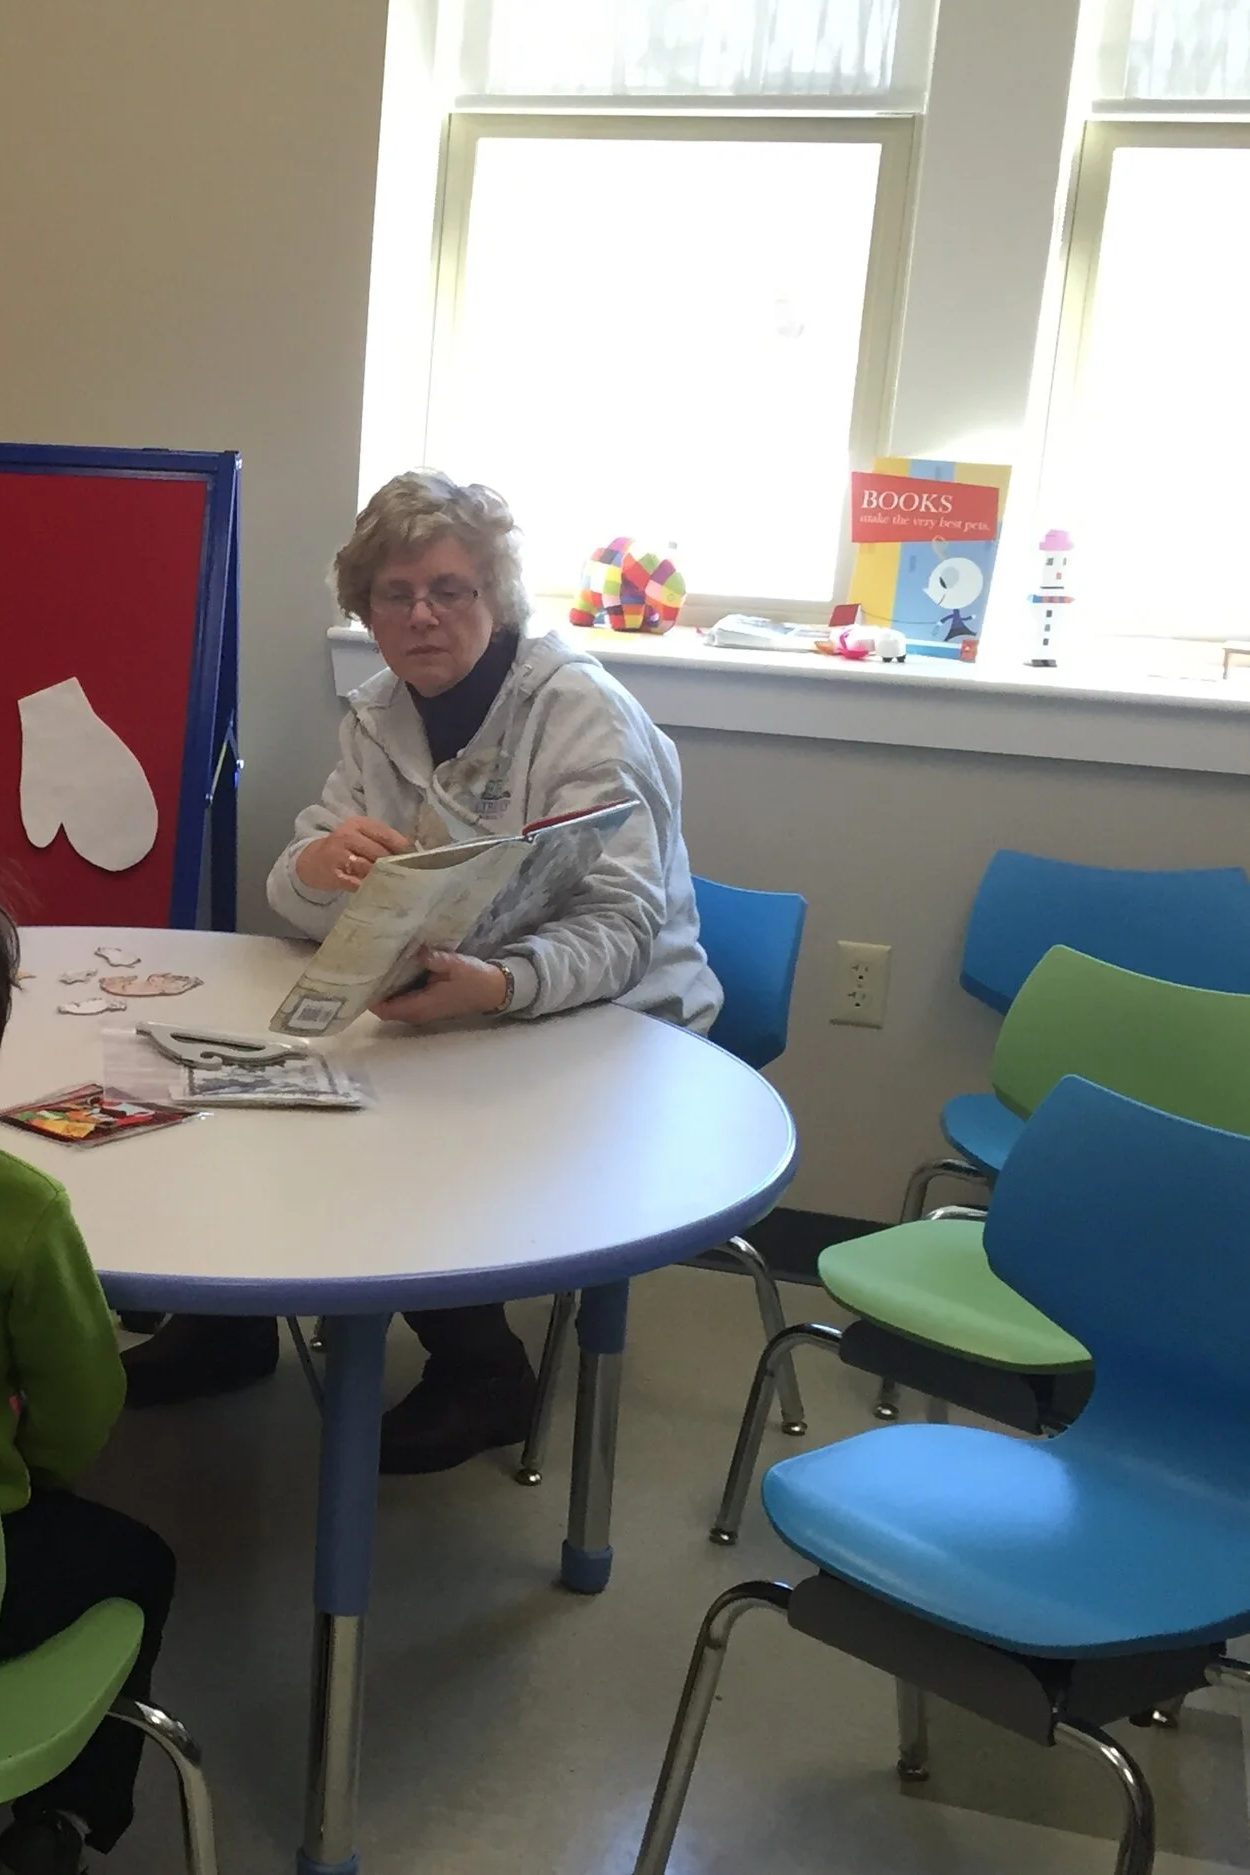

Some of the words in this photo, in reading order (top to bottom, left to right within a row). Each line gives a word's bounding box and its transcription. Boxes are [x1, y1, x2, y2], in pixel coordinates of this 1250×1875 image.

[861, 489, 953, 514] BOOKS
[859, 512, 890, 525] make
[892, 514, 910, 526] the
[913, 517, 937, 531] very
[939, 516, 962, 530] best
[963, 520, 990, 532] pets.
